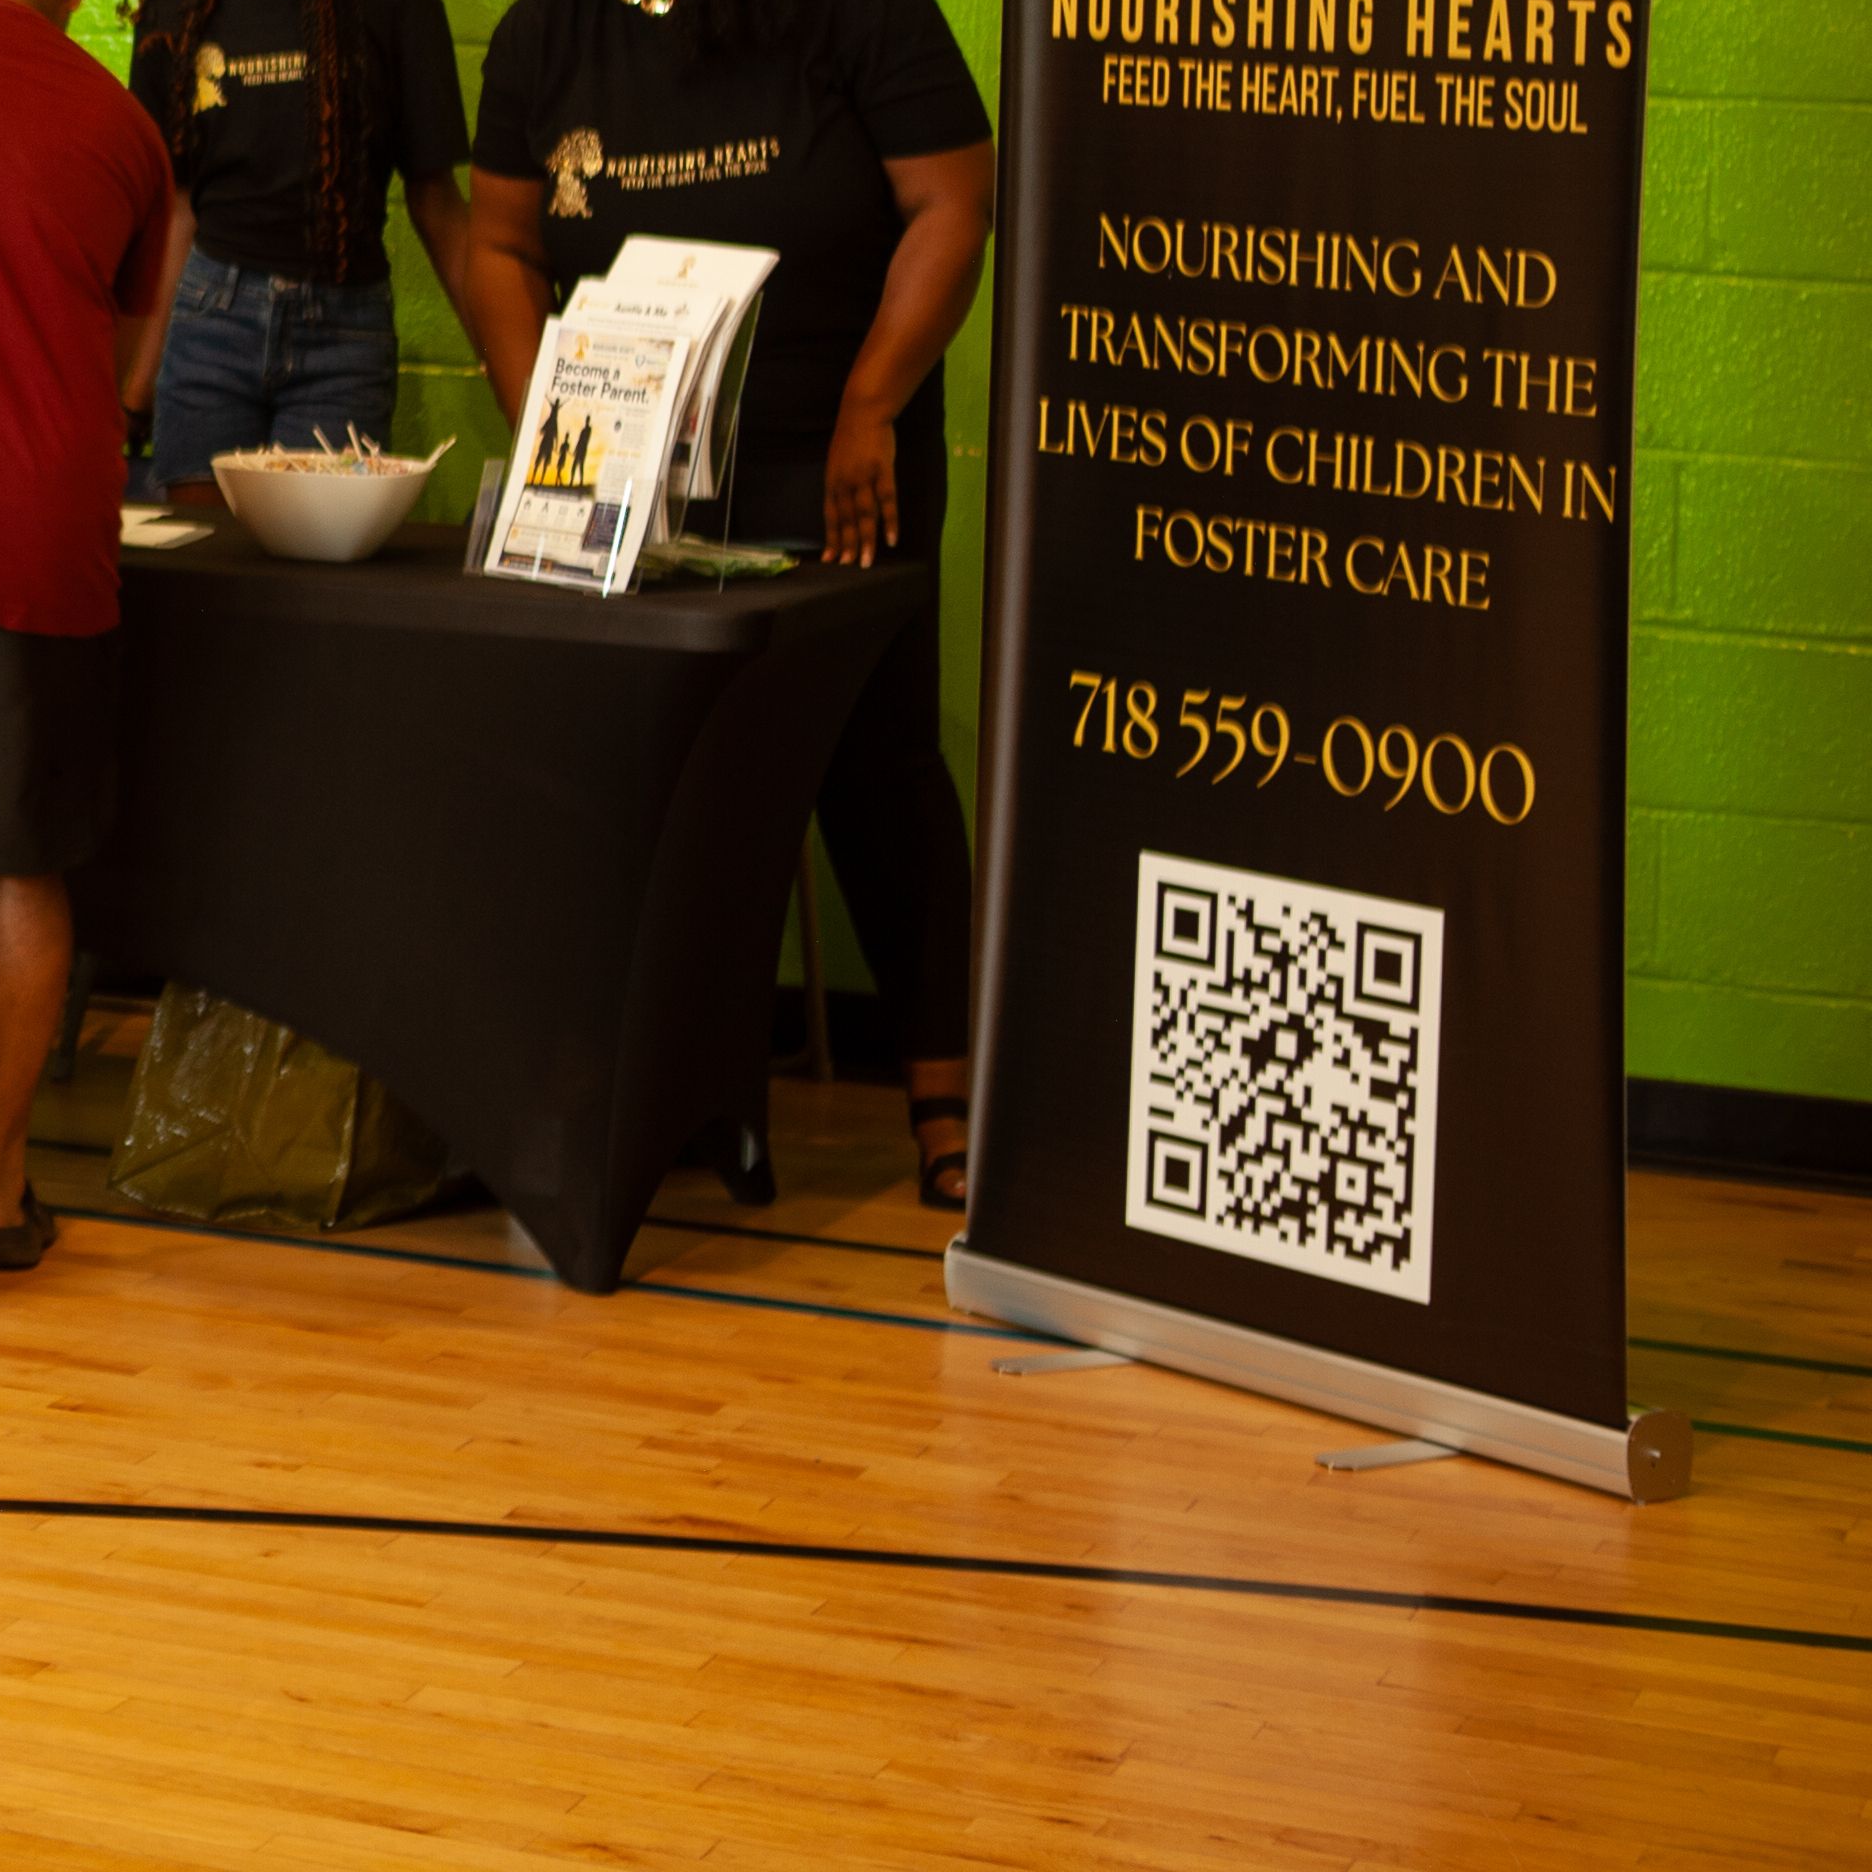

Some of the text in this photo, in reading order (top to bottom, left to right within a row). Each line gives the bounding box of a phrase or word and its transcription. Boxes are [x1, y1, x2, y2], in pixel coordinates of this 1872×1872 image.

[1103, 54, 1588, 134] FEED THE HEART, FUEL THE SOUL
[1099, 213, 1557, 310] NOURISHING AND
[551, 378, 650, 405] Foster Parent.
[555, 357, 610, 379] Become
[613, 369, 621, 381] a
[1060, 303, 1598, 418] TRANSFORMING THE
[1038, 396, 1617, 524] LIVES OF CHILDREN IN
[1134, 504, 1491, 610] FOSTER CARE
[1068, 668, 1536, 826] 718 559-0900
